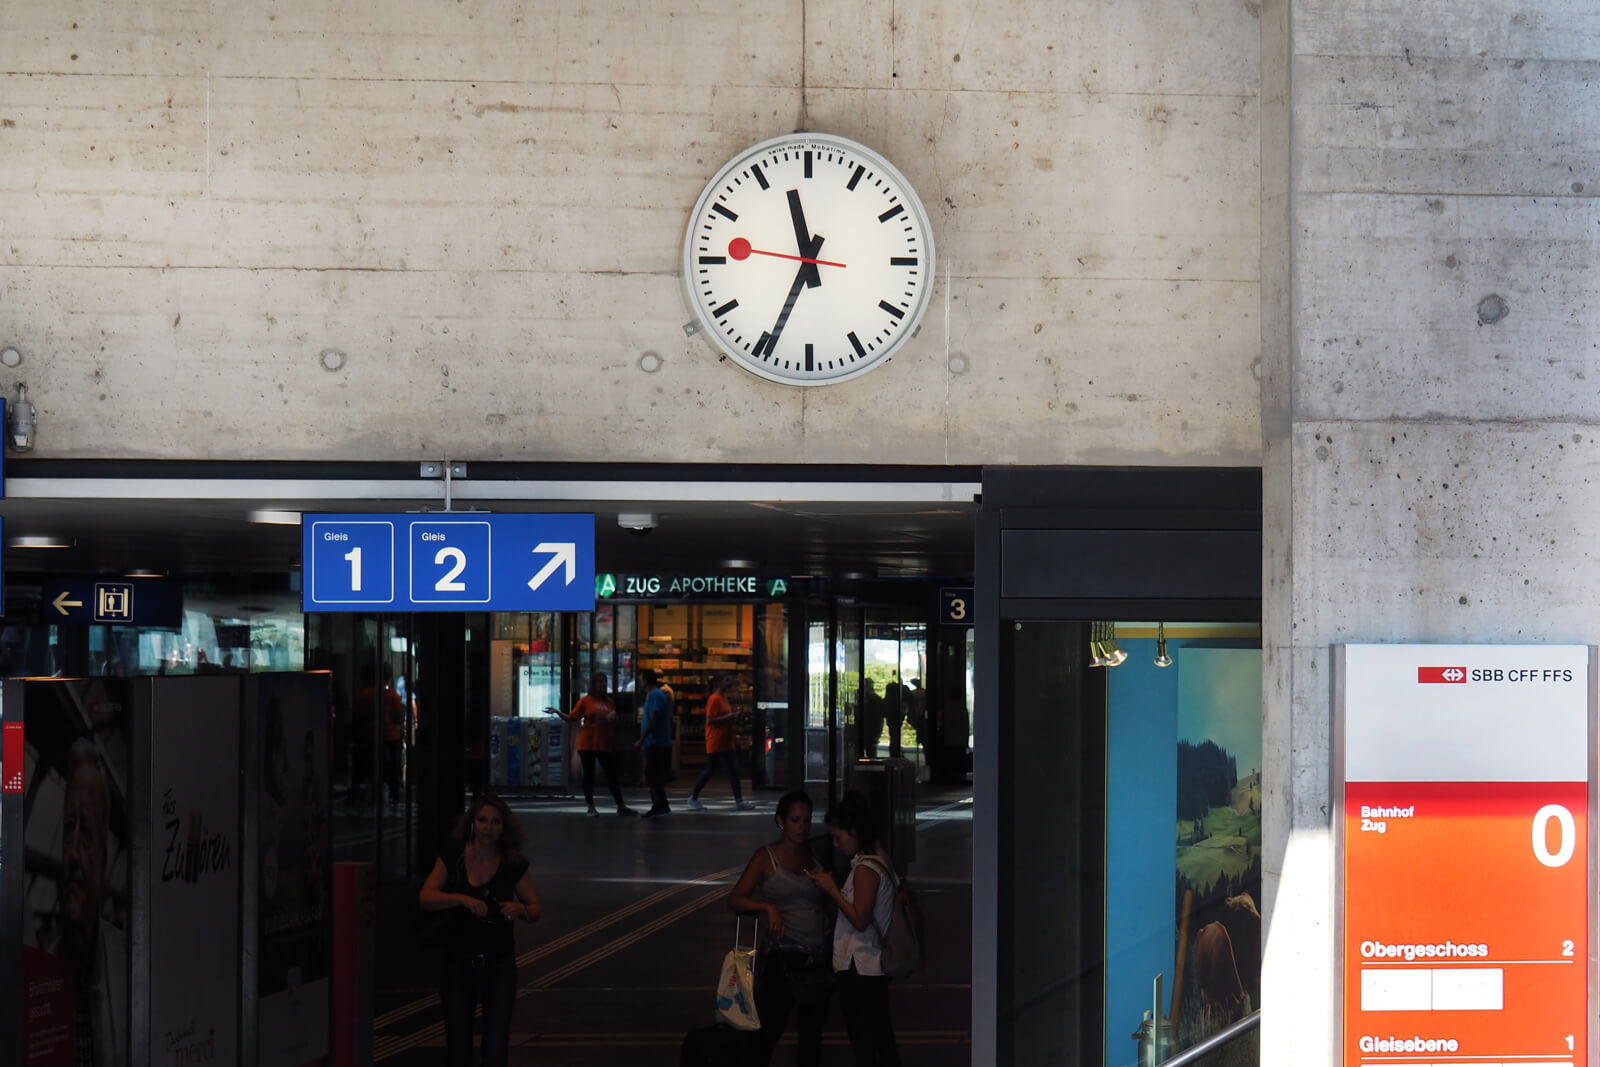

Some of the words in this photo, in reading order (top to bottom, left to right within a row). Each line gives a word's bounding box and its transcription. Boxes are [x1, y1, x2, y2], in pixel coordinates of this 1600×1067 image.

[768, 147, 786, 156] swiss
[811, 144, 846, 155] Mobatime
[324, 532, 348, 542] Gleis
[421, 532, 446, 542] Gleis
[344, 547, 362, 592] 1
[434, 547, 467, 592] 2
[626, 577, 661, 594] ZUG
[669, 577, 757, 593] APOTHEKE
[950, 598, 967, 620] 3
[1471, 668, 1504, 682] SBB
[1508, 668, 1539, 682] CFF
[1543, 668, 1573, 682] FFS
[1360, 805, 1415, 819] Bahnhof
[1360, 819, 1387, 834] Zug
[1530, 803, 1577, 869] 0
[1360, 939, 1489, 961] Obergeschoss
[1561, 939, 1575, 957] 2
[1359, 1035, 1460, 1053] Gleisebene
[1564, 1034, 1575, 1051] 1
